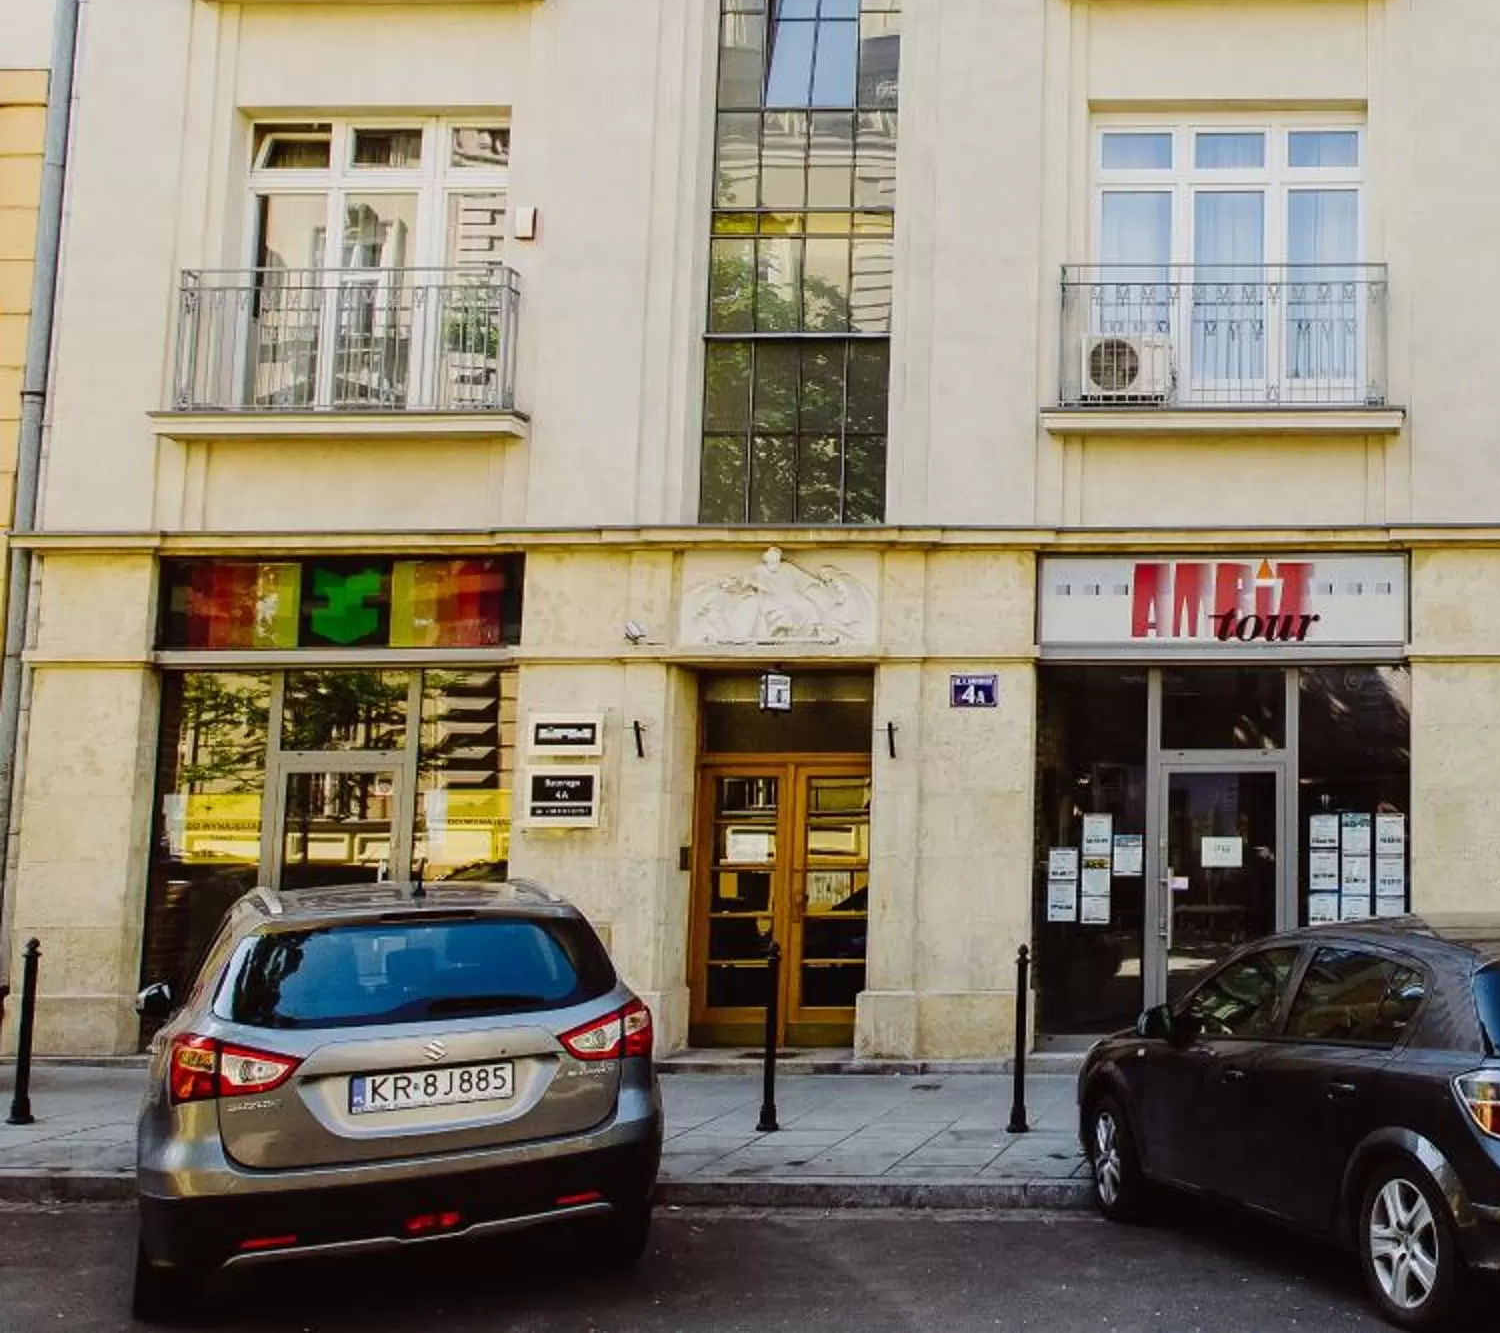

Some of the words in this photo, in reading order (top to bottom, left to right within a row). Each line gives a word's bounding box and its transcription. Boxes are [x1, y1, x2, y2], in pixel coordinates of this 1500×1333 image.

[1208, 607, 1321, 642] tour
[961, 685, 985, 704] 4A
[371, 1075, 412, 1103] KR
[423, 1066, 507, 1098] 8J885
